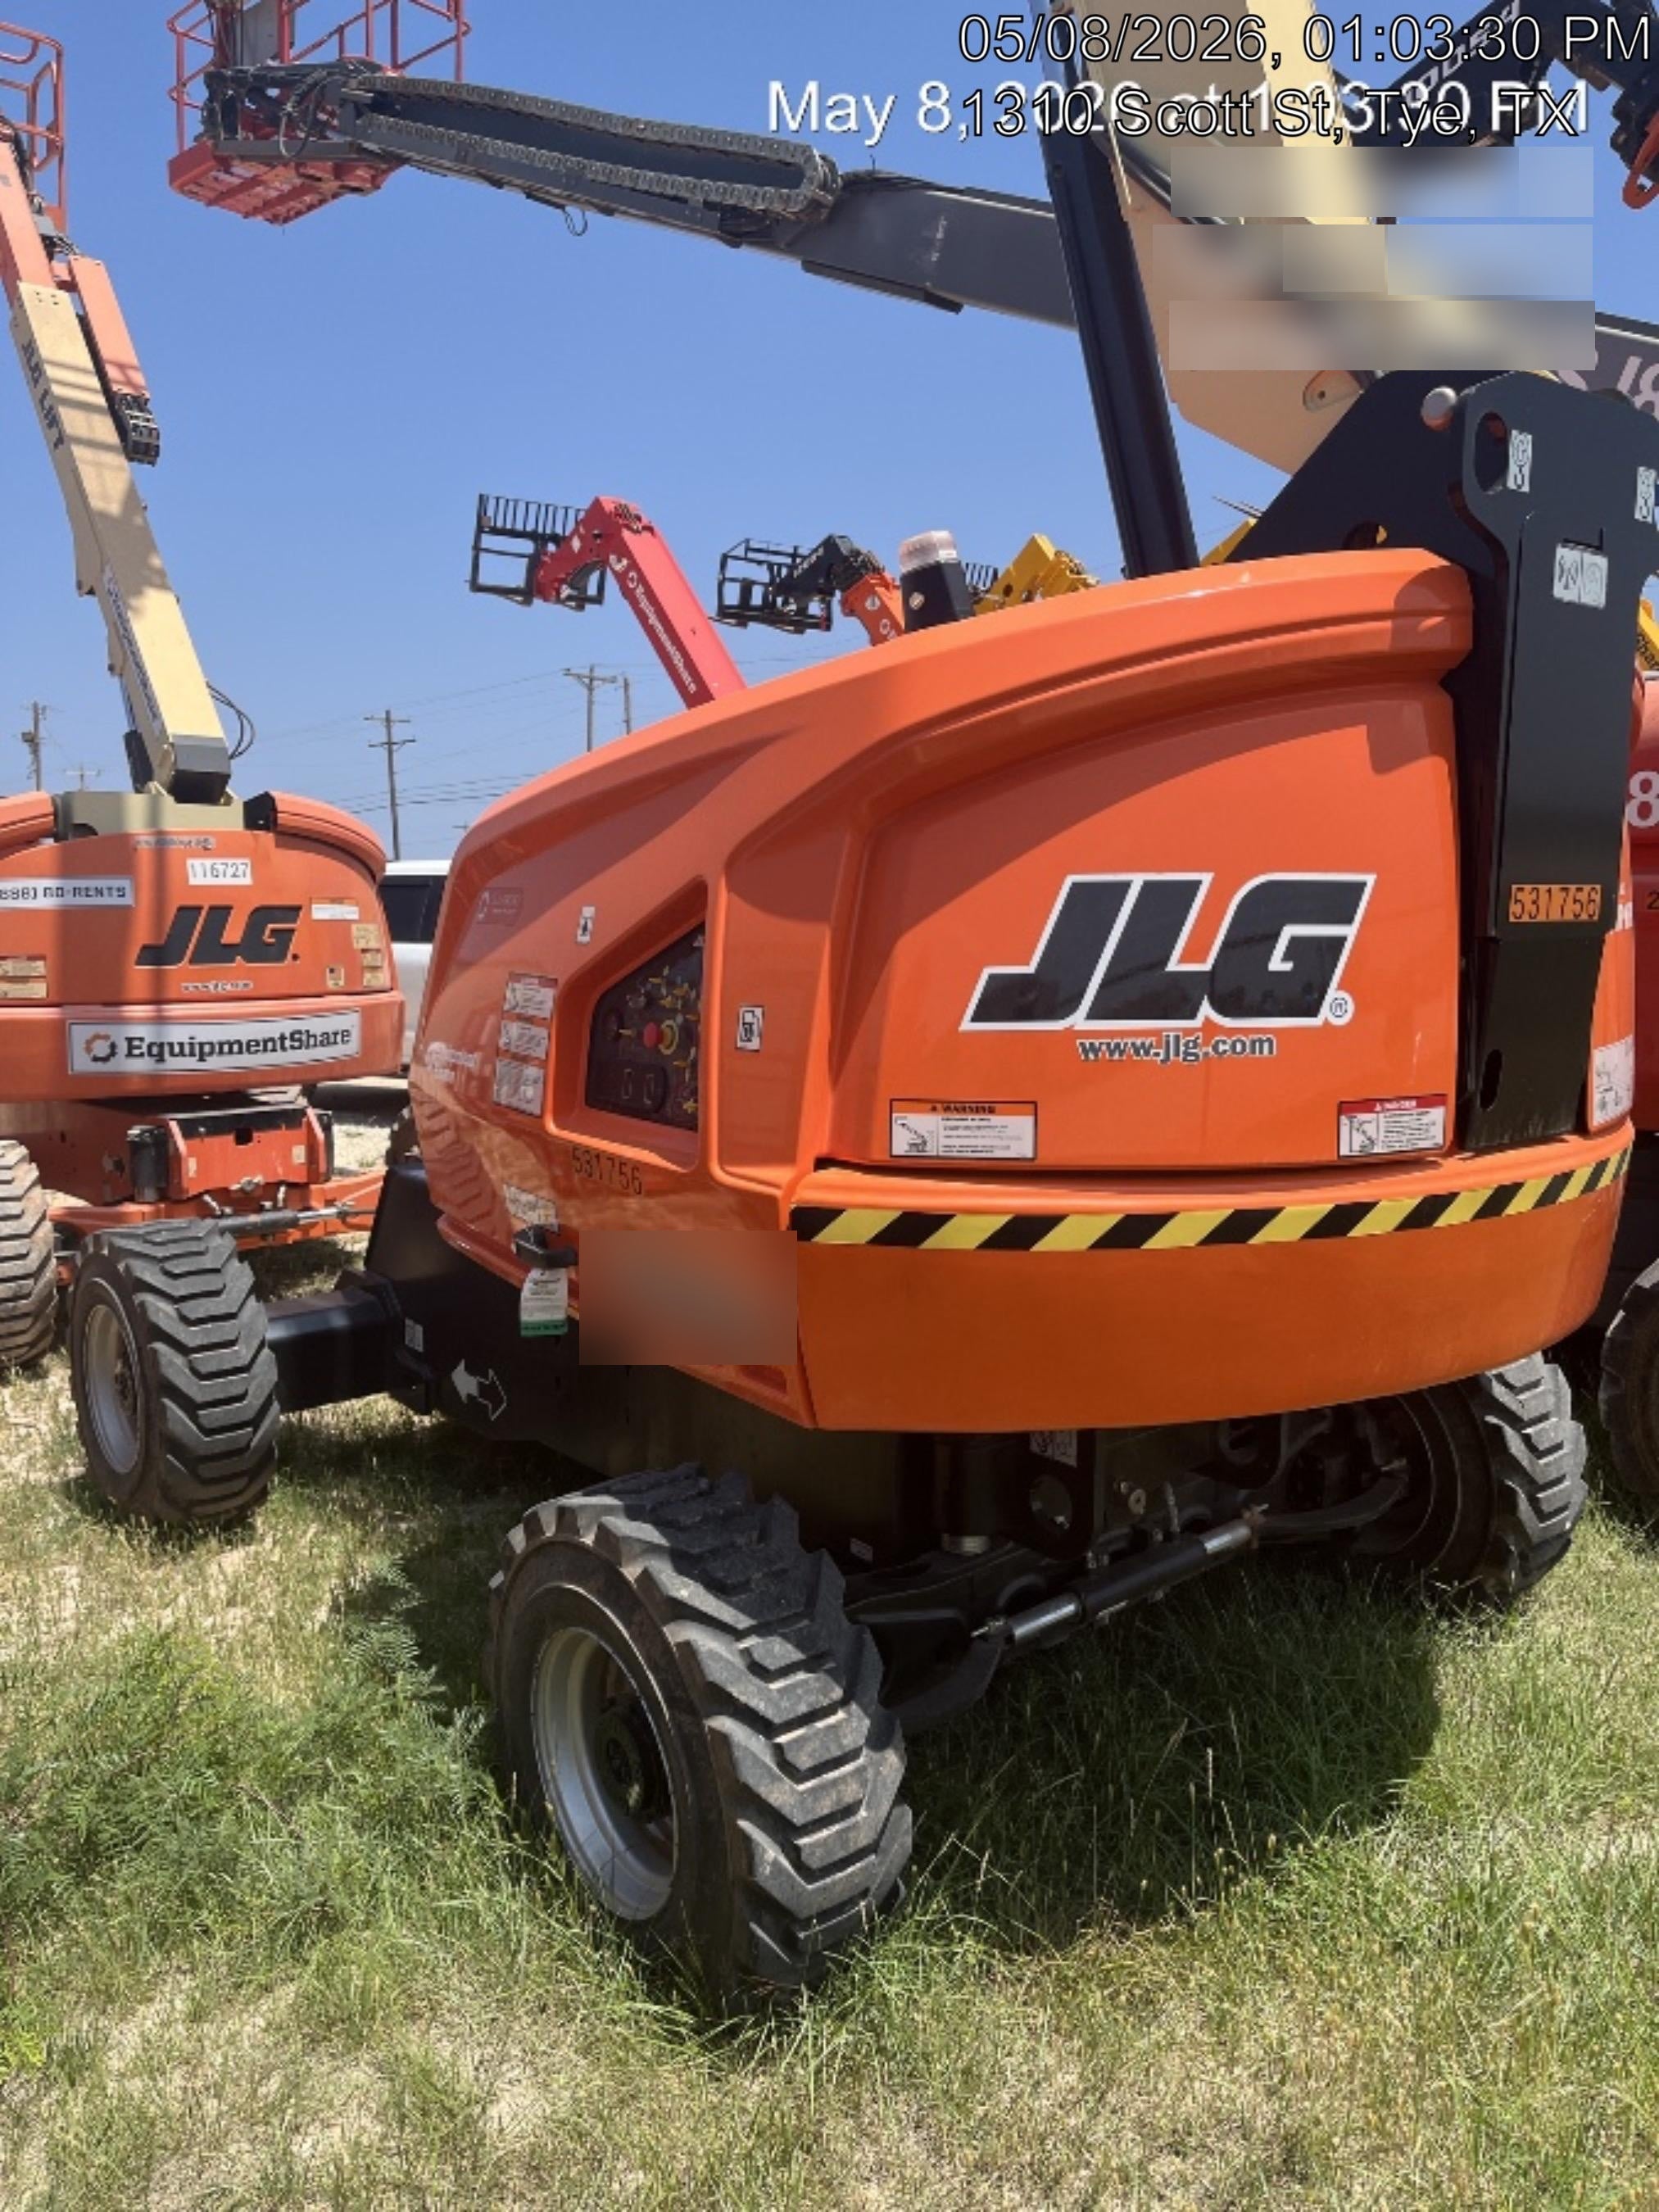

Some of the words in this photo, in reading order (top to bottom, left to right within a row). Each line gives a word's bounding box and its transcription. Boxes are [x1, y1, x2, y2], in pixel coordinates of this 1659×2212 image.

[190, 862, 248, 879] 116727
[1513, 886, 1599, 919] 531756
[135, 905, 302, 966] JLG
[959, 872, 1377, 1031] JLG
[125, 1029, 351, 1063] EquipmentShare
[1077, 1031, 1277, 1064] www.jlg.com
[573, 1146, 642, 1195] 531756
